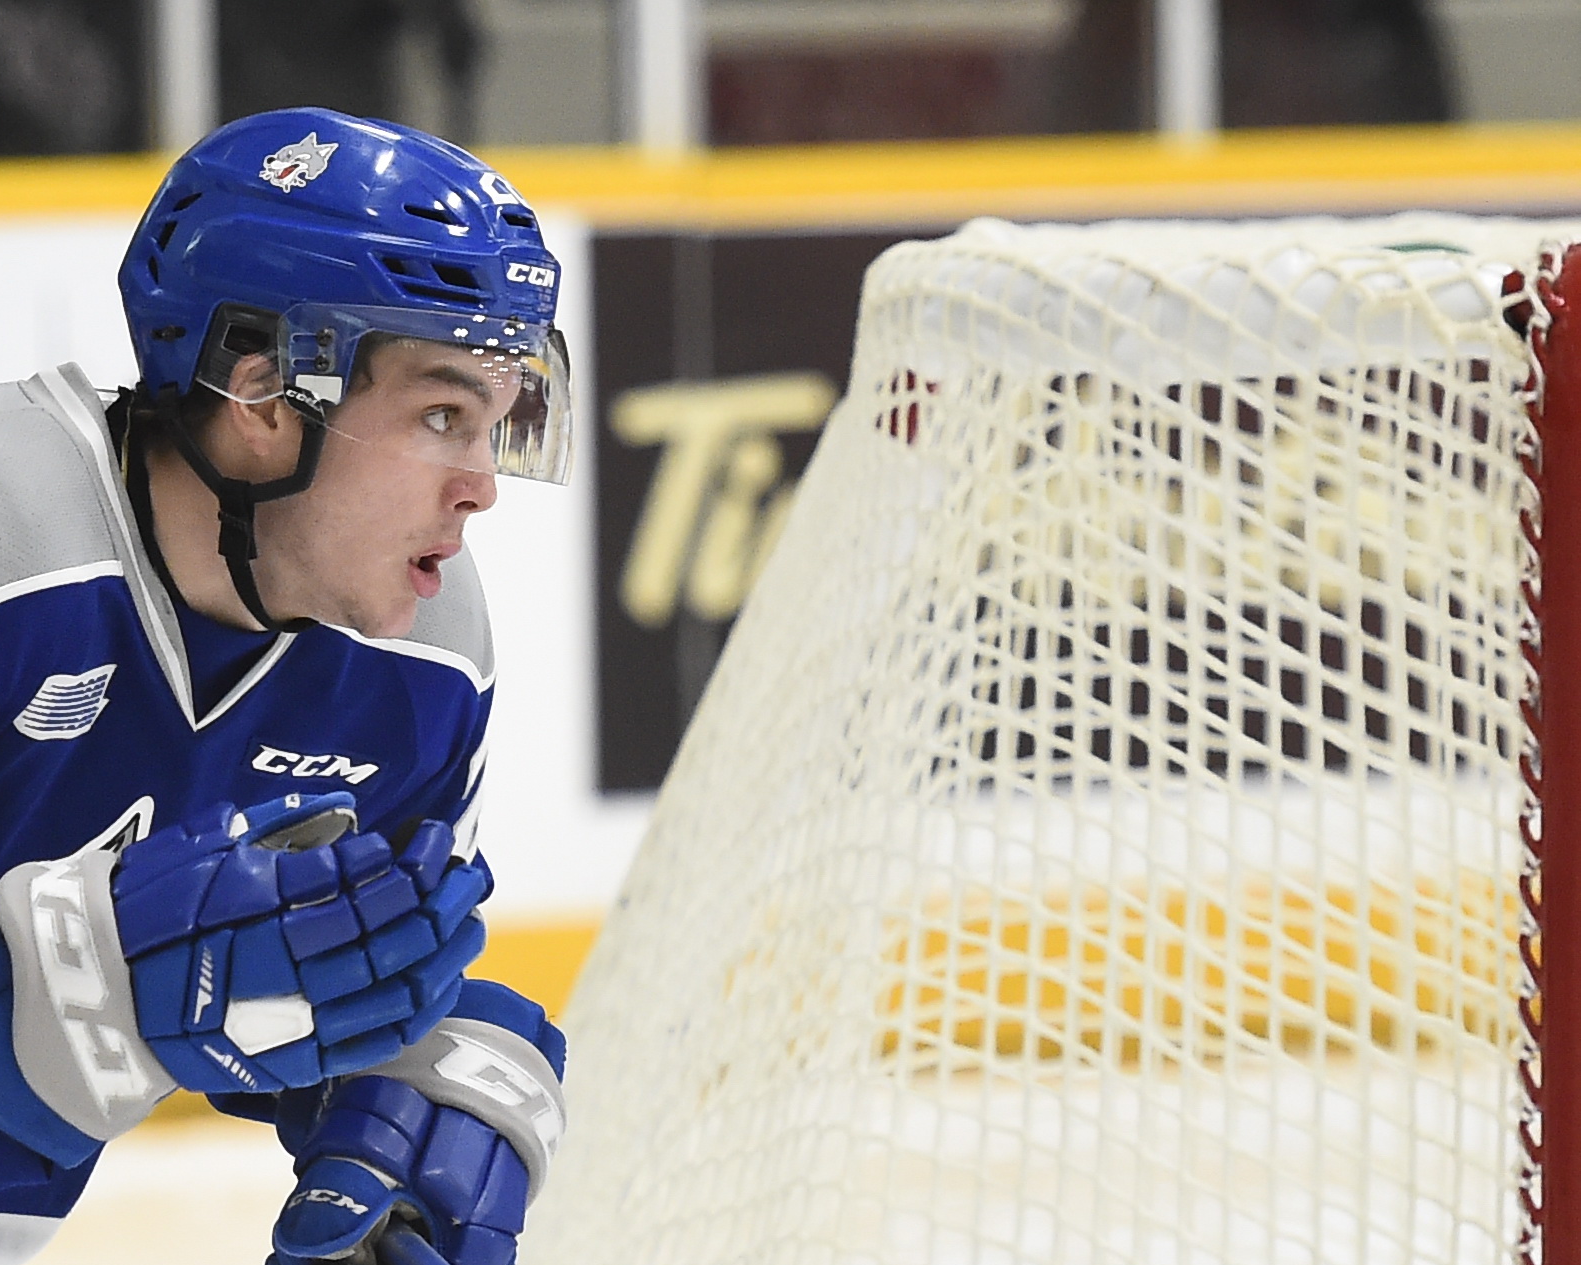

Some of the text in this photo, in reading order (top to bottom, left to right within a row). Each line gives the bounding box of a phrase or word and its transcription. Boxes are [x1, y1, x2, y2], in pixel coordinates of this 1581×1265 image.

[612, 372, 839, 628] Ti
[251, 744, 380, 785] CCM
[287, 1188, 370, 1216] CCM
